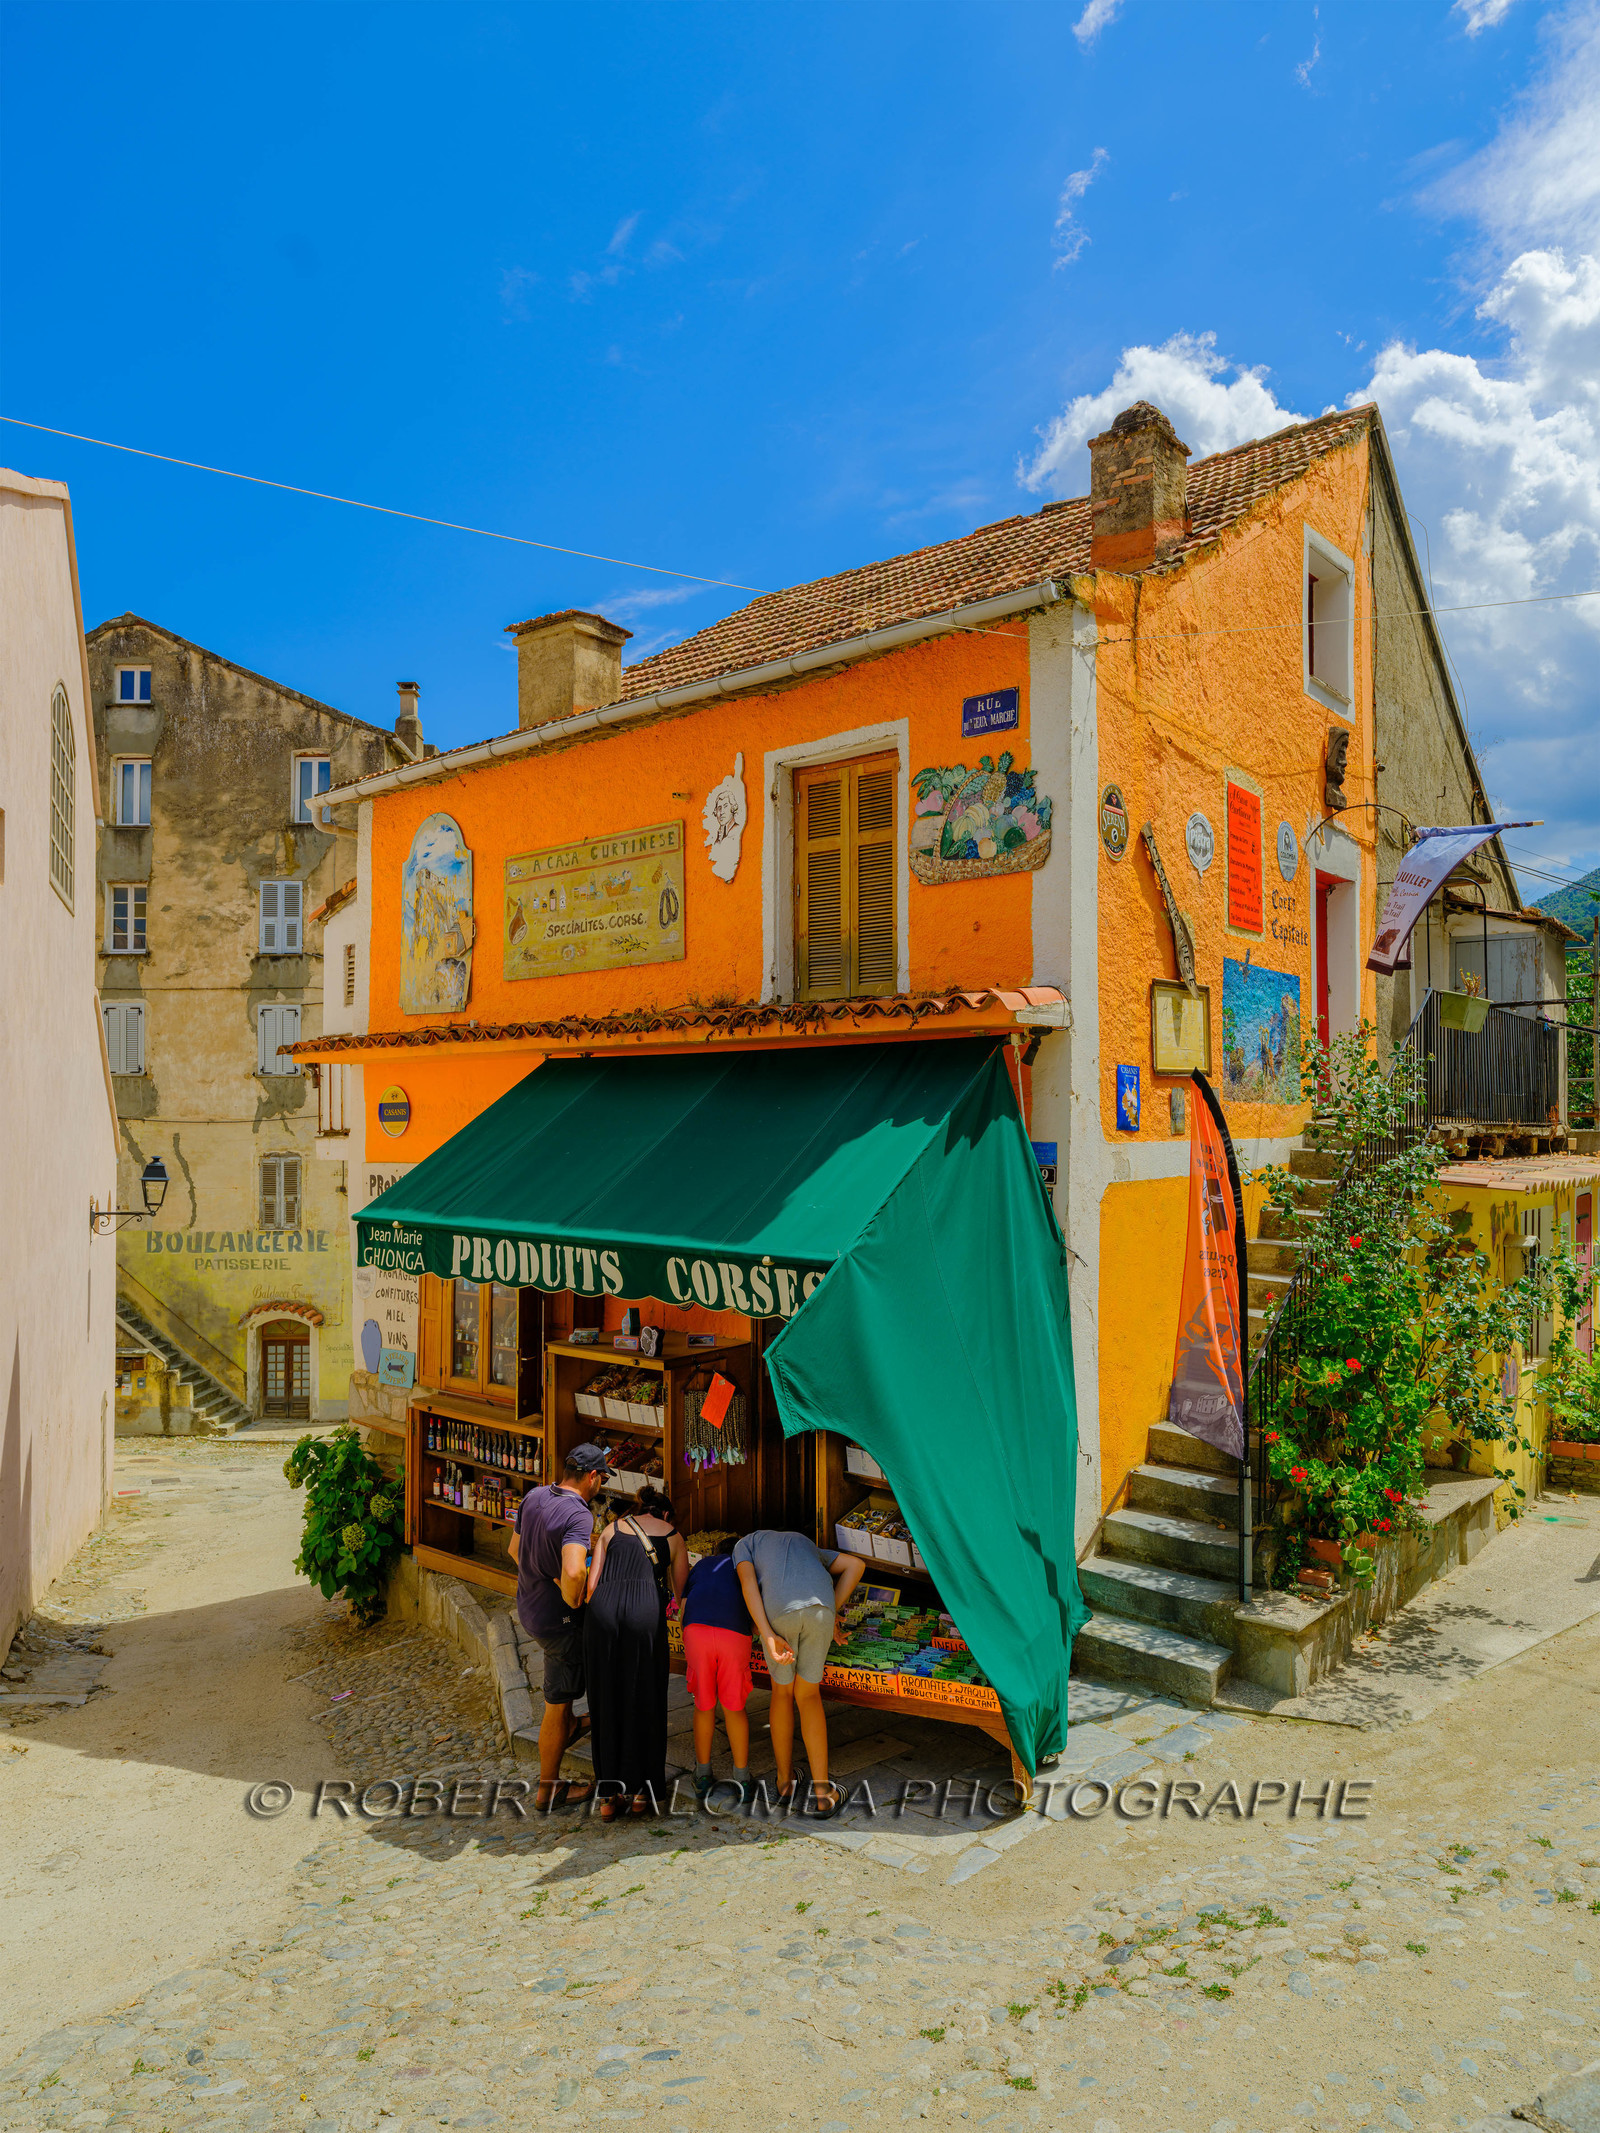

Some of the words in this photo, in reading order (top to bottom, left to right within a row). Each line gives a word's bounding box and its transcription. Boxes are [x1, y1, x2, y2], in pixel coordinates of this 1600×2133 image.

[977, 697, 1001, 712] RUE
[1103, 810, 1127, 838] SERENA
[533, 860, 541, 873] A
[547, 851, 579, 869] CASA
[590, 831, 675, 861] CURTINESE
[1397, 872, 1432, 889] JUILLET
[383, 1108, 407, 1116] CASANIS
[146, 1230, 330, 1253] BOULANGERIE
[369, 1226, 391, 1242] Jean
[393, 1228, 423, 1246] Marie
[194, 1257, 291, 1271] PATISSERIE
[363, 1247, 426, 1271] GHIONGA
[451, 1235, 624, 1295] PRODUITS
[375, 1286, 419, 1304] CONFITURES
[386, 1309, 406, 1322] MIEL
[387, 1331, 408, 1350] VINS
[384, 1352, 409, 1366] ATELIER
[832, 1671, 844, 1679] de
[848, 1671, 888, 1685] MYRTE
[901, 1675, 952, 1693] AROMATES
[903, 1687, 948, 1702] PRODUCTEUR
